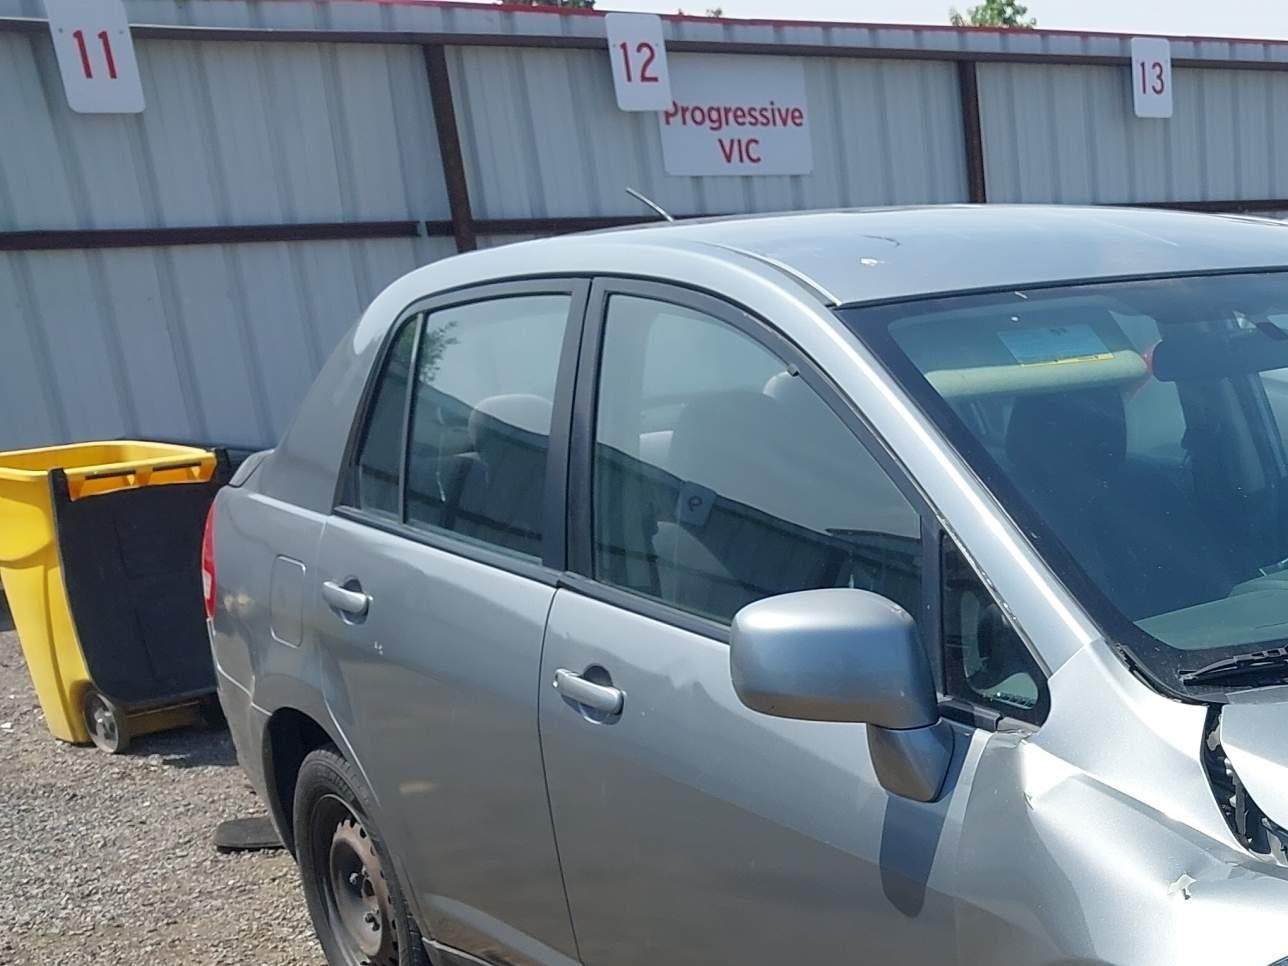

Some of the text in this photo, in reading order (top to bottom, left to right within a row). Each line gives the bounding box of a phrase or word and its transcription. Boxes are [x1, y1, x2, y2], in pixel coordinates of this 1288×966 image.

[72, 30, 118, 79] 11
[619, 41, 660, 83] 12
[1139, 61, 1165, 95] 13
[664, 100, 805, 131] Progressive
[718, 138, 762, 164] VIC
